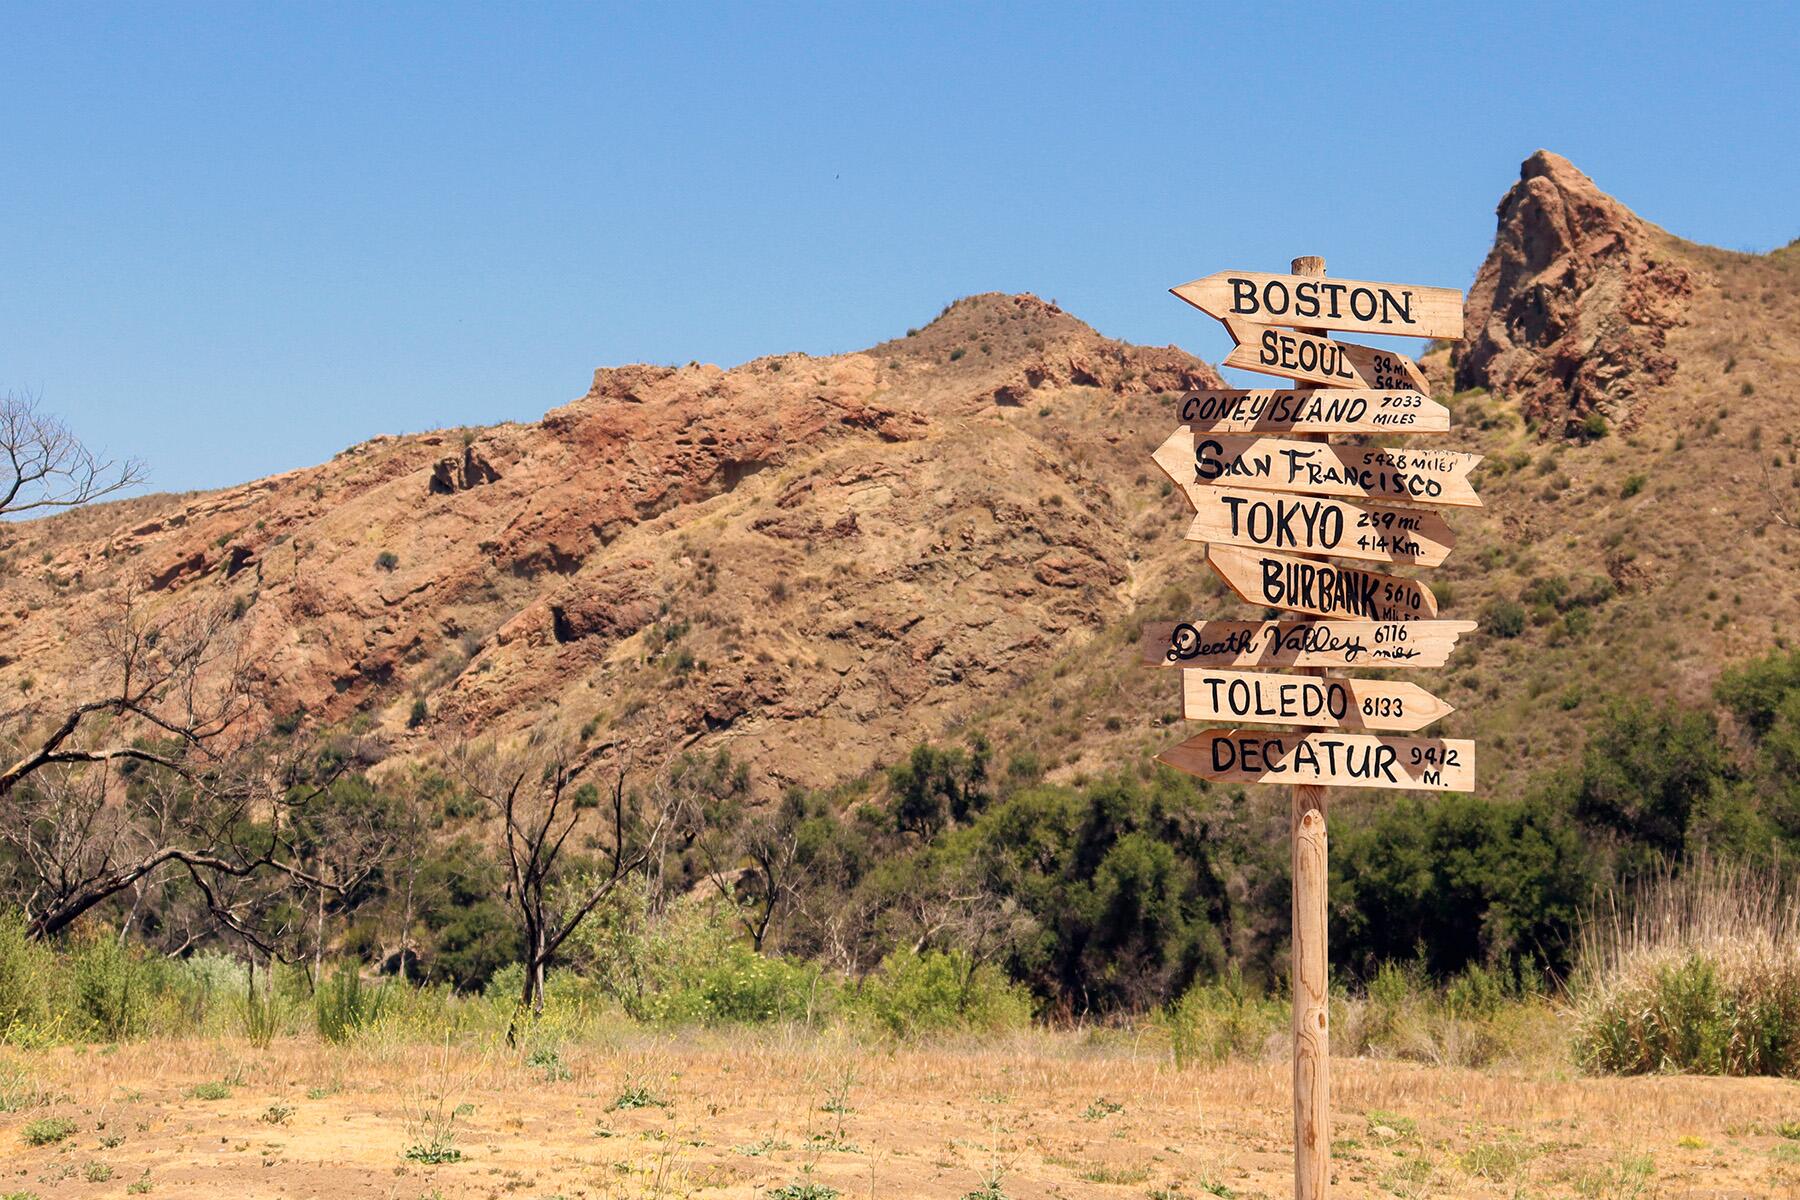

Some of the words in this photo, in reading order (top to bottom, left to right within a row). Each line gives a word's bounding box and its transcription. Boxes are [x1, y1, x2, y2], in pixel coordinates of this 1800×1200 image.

[1227, 278, 1416, 324] BOSTON
[1259, 330, 1354, 379] SEOUL
[1182, 395, 1268, 422] CONEY
[1267, 395, 1368, 423] ISLAND
[1380, 396, 1422, 409] 7033
[1372, 413, 1416, 425] MILES
[1279, 449, 1442, 498] FRANCISCO
[1363, 453, 1407, 470] 5428
[1221, 496, 1344, 549] TOKYO
[1357, 511, 1396, 530] 259
[1398, 515, 1422, 531] mi
[1357, 535, 1389, 553] 414
[1259, 558, 1380, 621] BURBANK
[1384, 582, 1420, 610] 5610
[1167, 623, 1258, 662] Death
[1264, 625, 1367, 662] Valley
[1203, 678, 1348, 720] TOLEDO
[1362, 697, 1403, 718] 8133
[1211, 737, 1398, 783] DECATUR
[1410, 747, 1461, 766] 9412
[1423, 771, 1449, 787] M.
